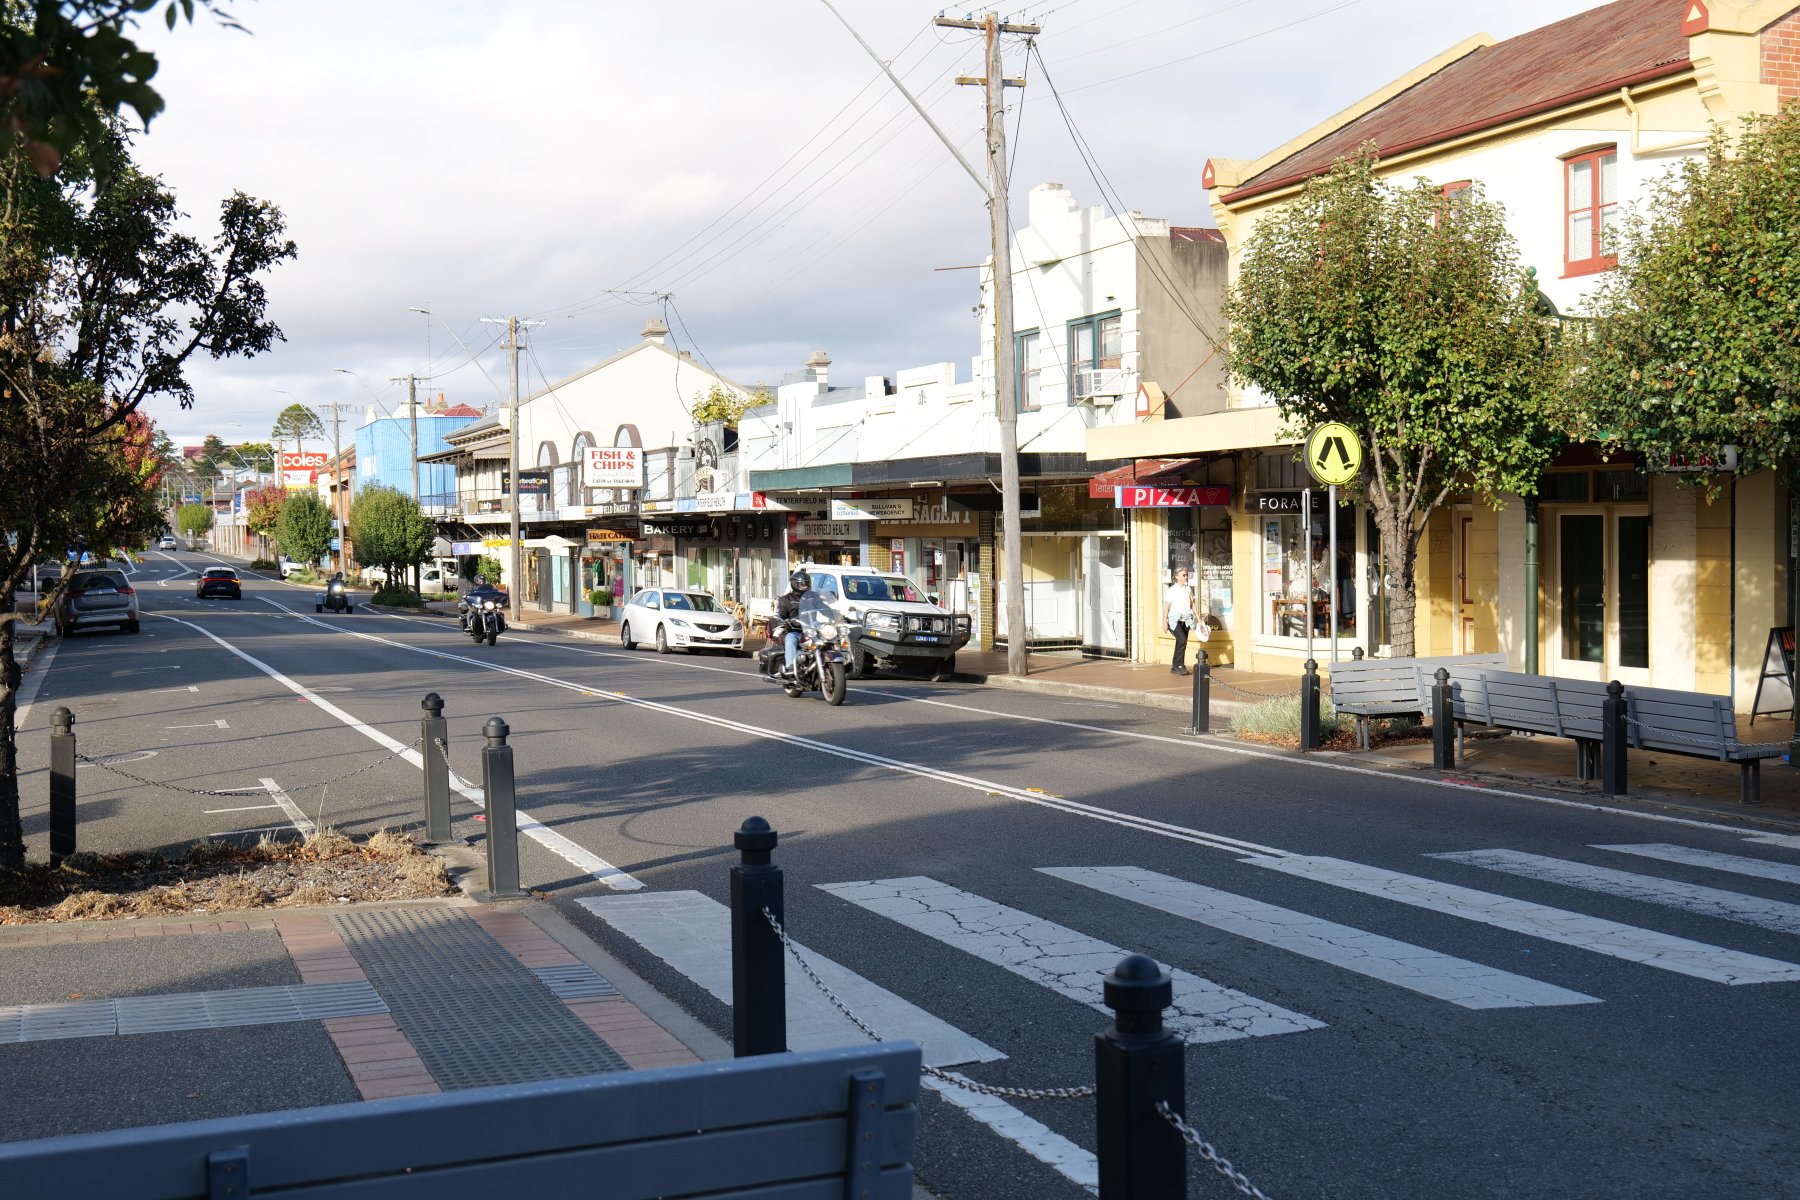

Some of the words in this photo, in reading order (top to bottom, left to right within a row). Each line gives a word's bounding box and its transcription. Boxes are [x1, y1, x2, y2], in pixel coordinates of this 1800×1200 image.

[283, 453, 324, 467] coles
[591, 451, 621, 460] FISH
[625, 451, 636, 460] &
[593, 461, 634, 470] CHIPS
[776, 497, 817, 505] TENTERFIELD
[1134, 488, 1200, 506] PIZZA
[1260, 497, 1319, 510] FORAE
[644, 524, 694, 535] BAKERY
[804, 524, 831, 536] TENTERFIELD
[833, 523, 850, 536] HEALTH
[589, 532, 607, 540] H&H
[1172, 553, 1187, 562] Pizza
